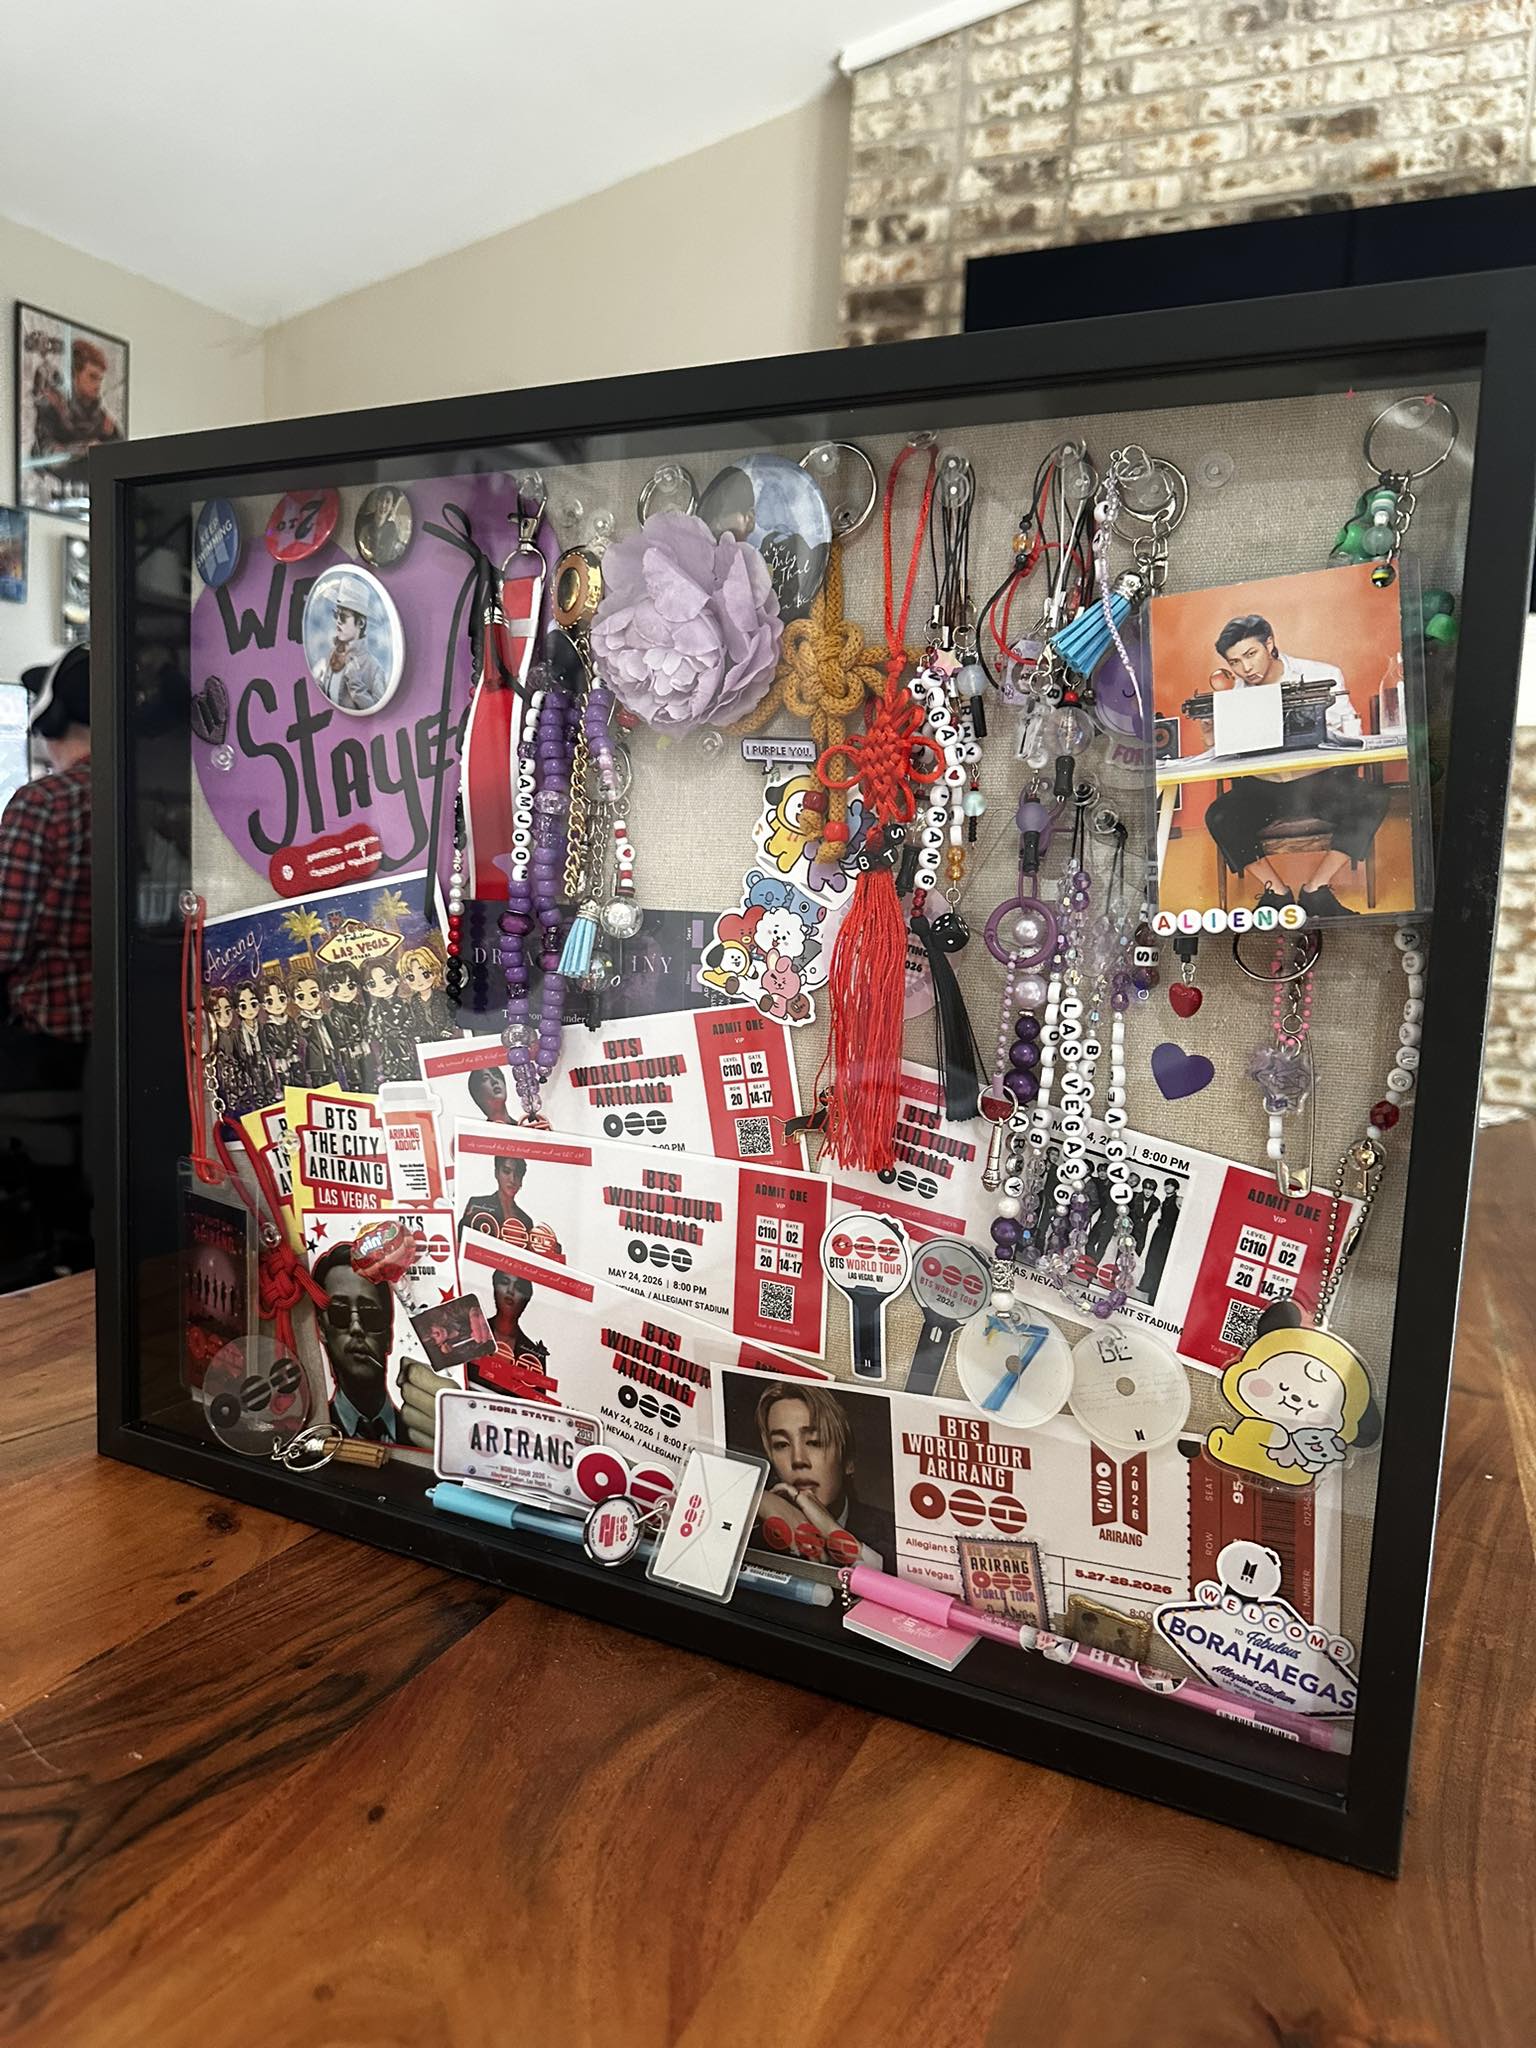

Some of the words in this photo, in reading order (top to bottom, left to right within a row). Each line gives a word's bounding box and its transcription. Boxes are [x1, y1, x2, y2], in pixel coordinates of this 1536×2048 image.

[196, 519, 233, 567] SWIMMING
[753, 745, 787, 757] PURPLE
[512, 758, 534, 881] NAMJOON
[858, 828, 904, 870] BTS
[1156, 907, 1299, 931] ALIENS
[331, 944, 354, 960] LAS
[355, 936, 391, 953] VEGAS
[712, 1020, 742, 1036] ADMIT
[745, 1018, 764, 1032] ONE
[607, 1038, 639, 1060] BTS
[575, 1061, 631, 1087] WORLD
[638, 1055, 682, 1079] TOUR
[722, 1064, 742, 1078] C110
[750, 1061, 763, 1075] 02
[596, 1082, 669, 1109] ARIRANG
[730, 1093, 743, 1107] 20
[749, 1090, 772, 1104] 14-17
[325, 1107, 357, 1131] BTS
[906, 1105, 939, 1129] BTS
[309, 1131, 338, 1155] THE
[343, 1134, 380, 1159] CITY
[388, 1128, 420, 1139] ARIRANG
[394, 1139, 421, 1151] ADDICT
[928, 1131, 970, 1162] TOUR
[309, 1156, 385, 1186] ARIRANG
[1142, 1148, 1168, 1166] 8:00
[1170, 1156, 1191, 1172] PM
[645, 1169, 678, 1193] BTS
[755, 1183, 785, 1199] ADMIT
[789, 1188, 808, 1203] ONE
[318, 1187, 338, 1205] LAS
[339, 1190, 377, 1210] VEGAS
[608, 1186, 665, 1215] WORLD
[672, 1196, 716, 1223] TOUR
[1247, 1188, 1291, 1212] ADMIT
[1295, 1204, 1322, 1223] ONE
[624, 1210, 699, 1243] ARIRANG
[1273, 1214, 1288, 1225] VIP
[757, 1225, 778, 1240] C110
[786, 1230, 799, 1244] 02
[1246, 1229, 1267, 1241] LEVEL
[1281, 1241, 1300, 1251] GATE
[760, 1254, 773, 1268] 20
[779, 1258, 803, 1275] 14-17
[1239, 1237, 1268, 1258] C110
[1278, 1250, 1297, 1268] 02
[418, 1266, 436, 1275] TOUR
[829, 1257, 845, 1270] BTS
[846, 1259, 877, 1273] WORLD
[879, 1262, 902, 1276] TOUR
[848, 1272, 857, 1280] LAS
[876, 1275, 884, 1283] NV
[1239, 1262, 1255, 1272] ROW
[1271, 1273, 1290, 1284] SEAT
[608, 1267, 627, 1279] MAY
[629, 1271, 642, 1284] 24,
[642, 1274, 664, 1287] 2026
[673, 1279, 695, 1293] 8:00
[693, 1283, 708, 1296] PM
[920, 1276, 933, 1289] BTS
[935, 1284, 958, 1299] WORLD
[960, 1293, 978, 1308] TOUR
[1234, 1271, 1253, 1289] 20
[652, 1291, 693, 1308] ALLEGIANT
[694, 1300, 730, 1317] STADIUM
[936, 1294, 955, 1308] 2026
[1136, 1311, 1185, 1335] STADIUM
[646, 1322, 677, 1351] BTS
[607, 1328, 663, 1368] WORLD
[668, 1352, 712, 1389] TOUR
[617, 1356, 692, 1406] ARIRANG
[488, 1404, 518, 1416] BORA
[521, 1410, 556, 1423] STATE
[600, 1405, 620, 1421] MAY
[620, 1414, 633, 1428] 24,
[634, 1420, 655, 1437] 2026
[663, 1434, 682, 1449] 8:00
[946, 1417, 980, 1441] BTS
[470, 1422, 574, 1470] ARIRANG
[606, 1424, 635, 1443] NEVADA
[641, 1440, 683, 1465] ALLEGIANT
[908, 1433, 968, 1461] WORLD
[975, 1443, 1024, 1468] TOUR
[926, 1459, 1006, 1488] ARIRANG
[1130, 1464, 1140, 1521] 2026
[1204, 1476, 1215, 1502] SEAT
[905, 1536, 949, 1554] Allegiant
[1098, 1527, 1143, 1548] ARIRANG
[1204, 1531, 1214, 1557] ROW
[906, 1564, 926, 1576] Las
[927, 1568, 955, 1582] Vegas
[970, 1557, 1030, 1574] ARIRANG
[1074, 1568, 1173, 1596] 5.27-28.2026
[973, 1588, 1007, 1600] WORLD
[1010, 1589, 1036, 1602] TOUR
[1129, 1606, 1154, 1620] 8:00
[1202, 1587, 1345, 1658] WELCOME
[1234, 1627, 1244, 1637] TO
[1246, 1631, 1302, 1660] Fabulous
[1088, 1647, 1133, 1672] BTS
[1168, 1616, 1357, 1710] BORAHAEGAS
[1211, 1665, 1256, 1688] Allegiant
[1255, 1681, 1297, 1705] Stadium
